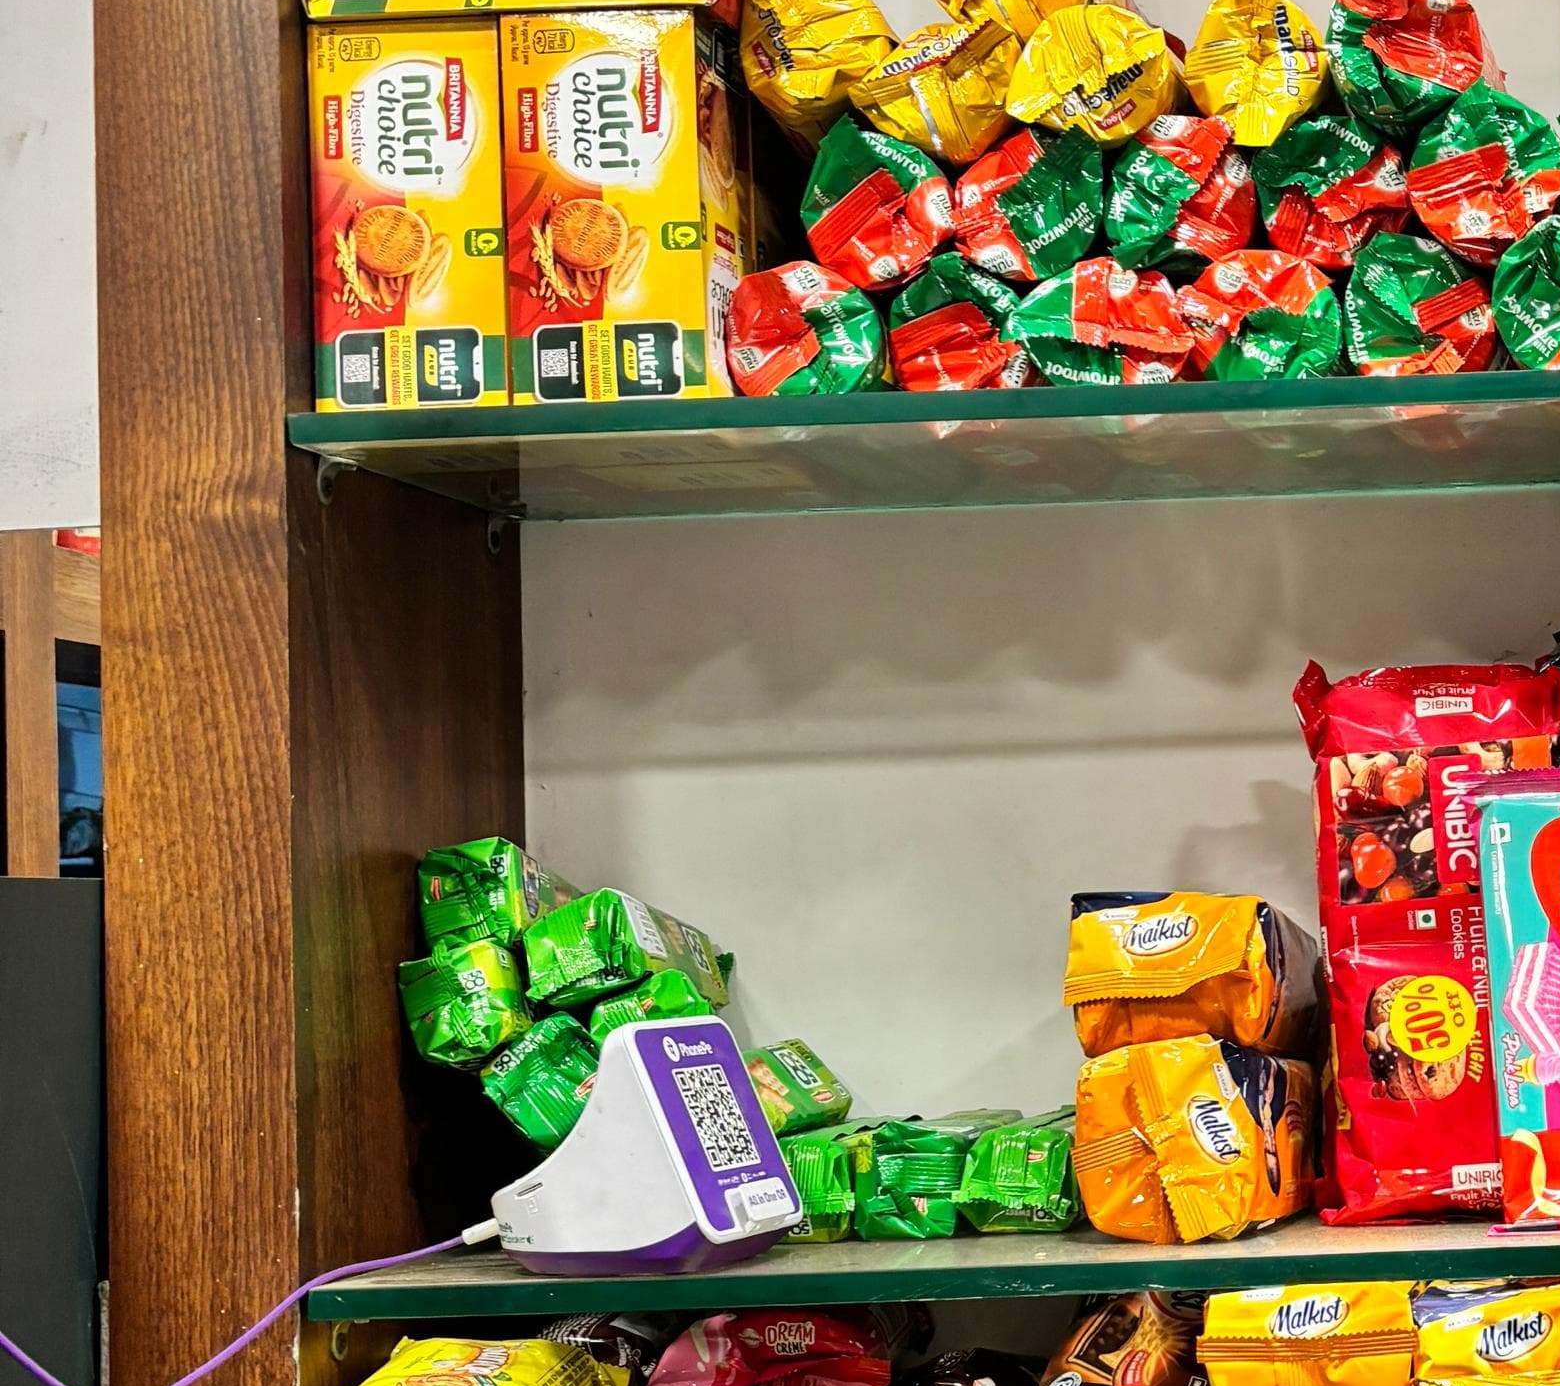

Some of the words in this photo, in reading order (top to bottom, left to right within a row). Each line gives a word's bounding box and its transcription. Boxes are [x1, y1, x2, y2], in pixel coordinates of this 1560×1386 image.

[346, 89, 365, 168] Digestive
[377, 78, 398, 176] choice
[400, 73, 443, 178] nutri
[446, 63, 463, 139] BRITANNIA
[543, 80, 559, 161] Digestive
[571, 71, 595, 169] choice
[596, 66, 640, 177] nutri
[1021, 201, 1089, 252] arrowroot
[1419, 699, 1470, 713] UNIBIC
[1450, 908, 1465, 960] Cookies
[1404, 982, 1451, 1054] 50%
[680, 1041, 713, 1057] PhonePe
[1504, 1033, 1523, 1073] Pink
[1503, 1073, 1520, 1109] Lava
[1192, 1098, 1241, 1161] Malkist
[765, 1321, 815, 1346] DREAM
[1272, 1297, 1344, 1337] Malkist
[1475, 1311, 1548, 1357] Malkist
